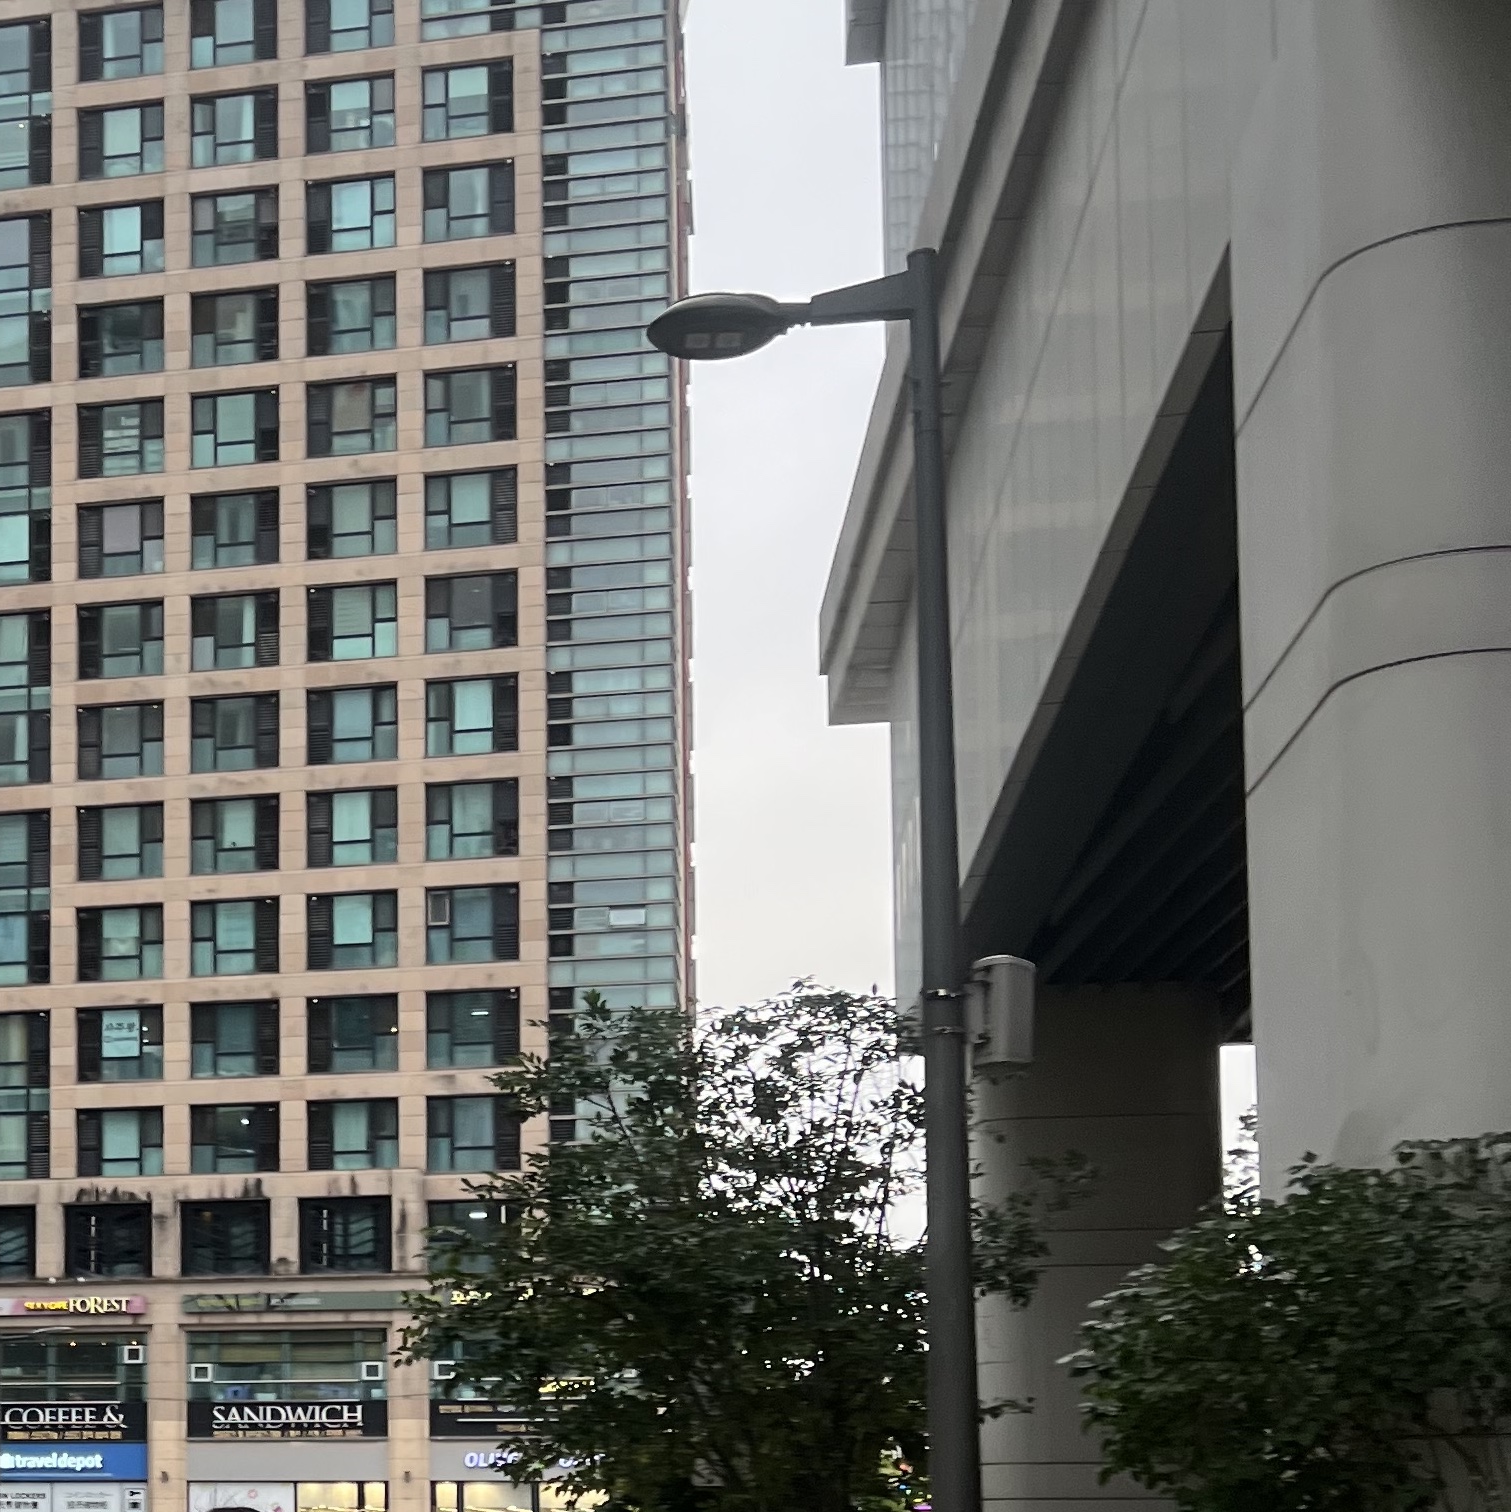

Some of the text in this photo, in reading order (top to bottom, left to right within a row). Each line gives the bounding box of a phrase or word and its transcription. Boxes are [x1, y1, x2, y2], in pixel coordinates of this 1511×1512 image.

[68, 1296, 130, 1315] FOREST
[4, 1407, 97, 1429] COFFEE
[103, 1404, 129, 1429] &
[212, 1404, 364, 1429] SANDWICH
